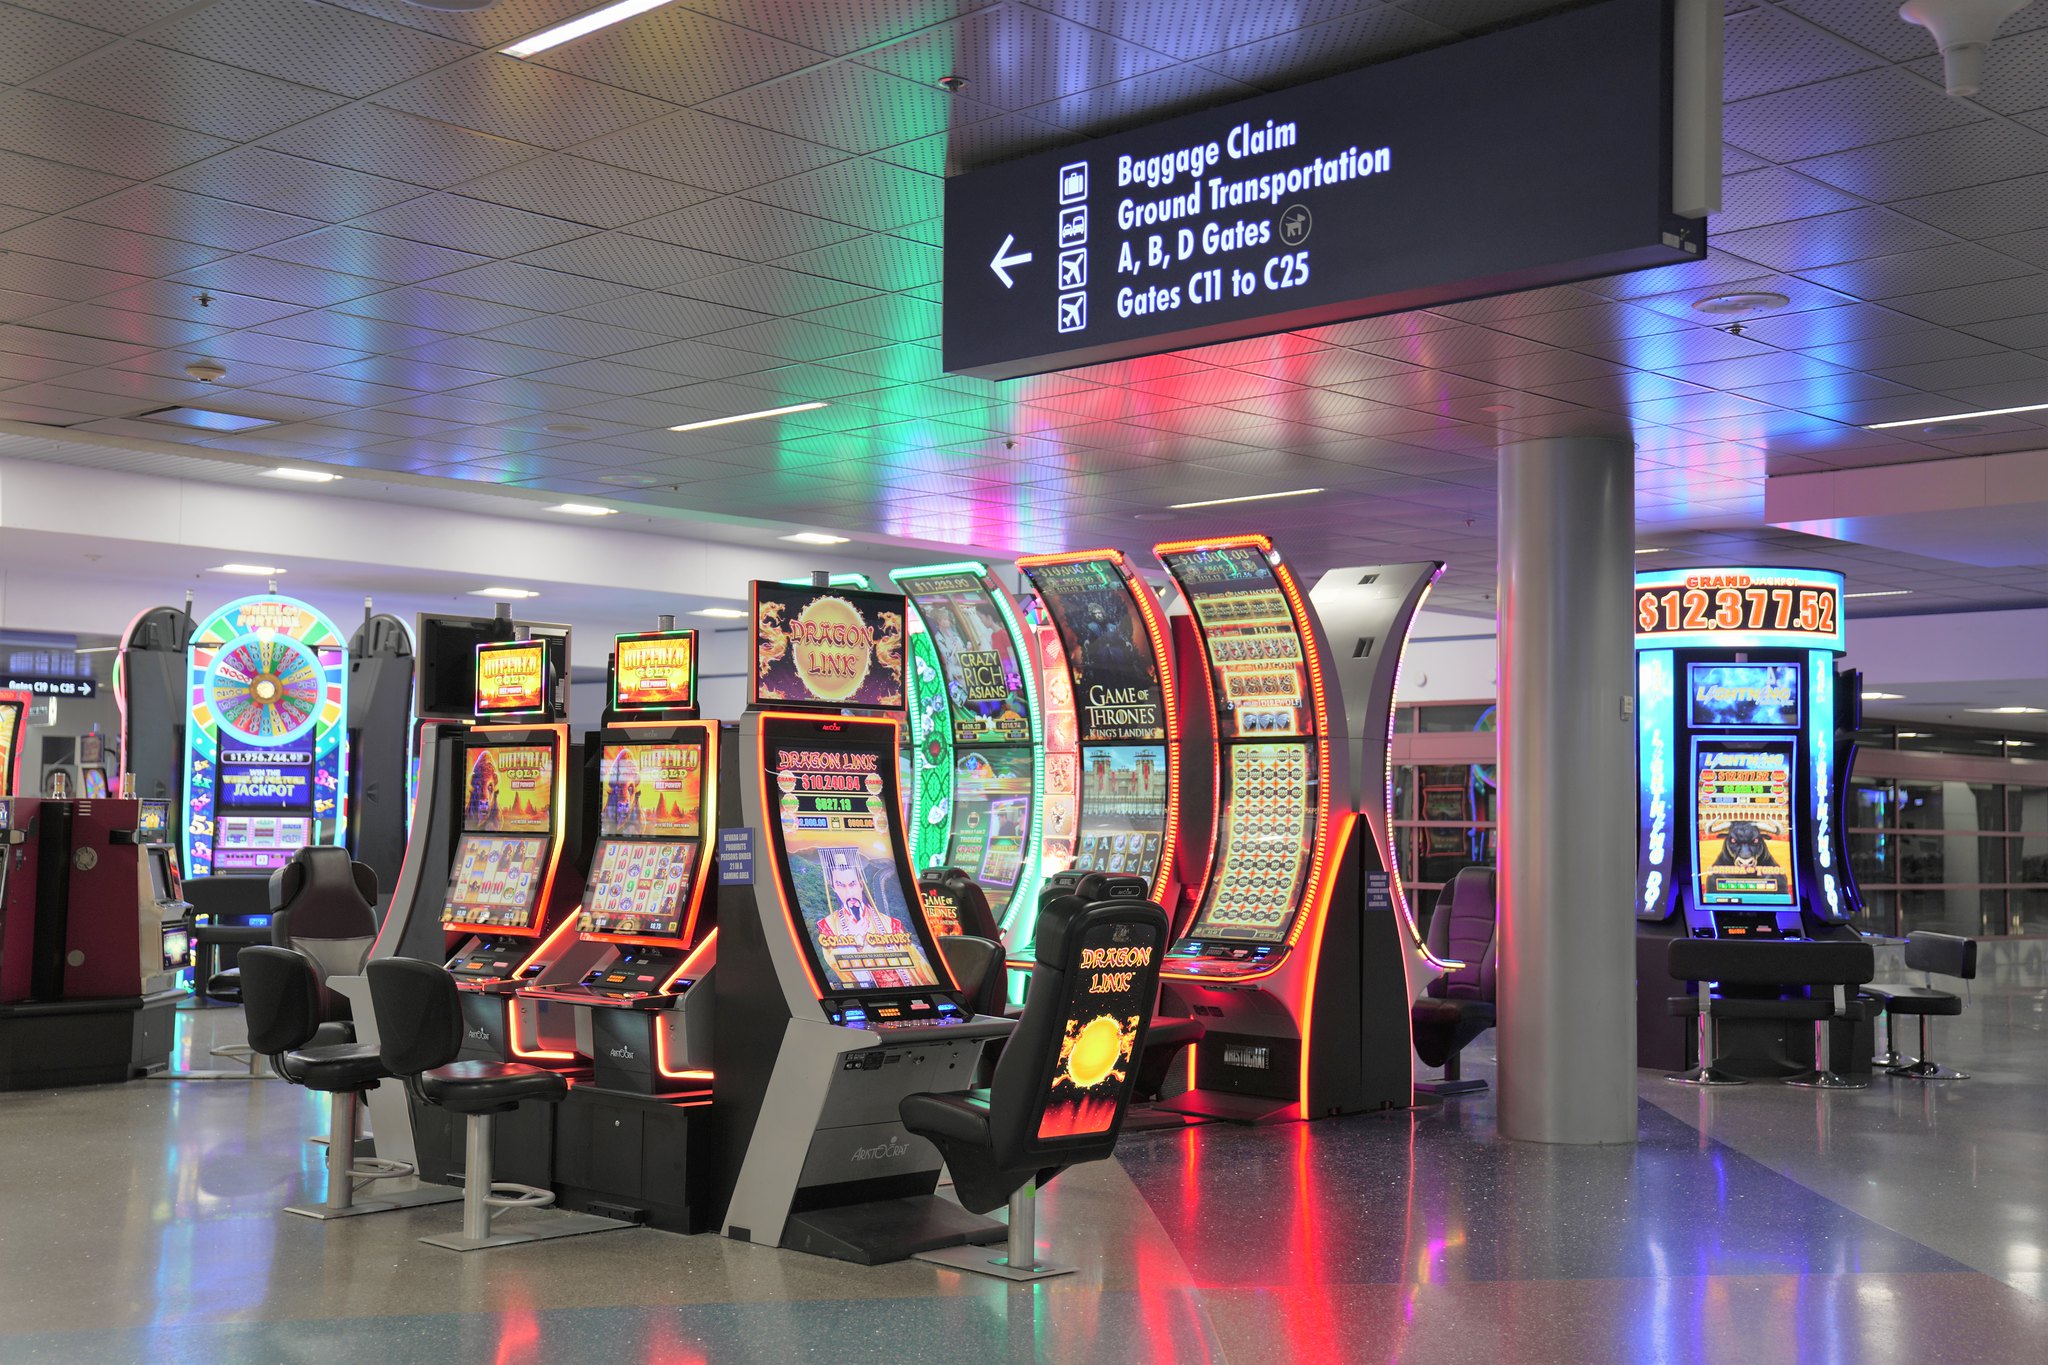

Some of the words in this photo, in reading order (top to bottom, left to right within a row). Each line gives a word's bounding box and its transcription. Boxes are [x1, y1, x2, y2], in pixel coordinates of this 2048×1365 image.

[1118, 141, 1219, 187] Baggage
[1227, 120, 1296, 159] Claim
[1118, 182, 1200, 230] Ground
[1208, 146, 1390, 209] Transportation
[1118, 243, 1140, 276] A,
[1148, 235, 1170, 270] B,
[1178, 229, 1194, 260] D
[1202, 219, 1270, 255] Gates
[1117, 282, 1180, 318] Gates
[1188, 270, 1221, 305] C11
[1232, 268, 1255, 297] to
[1264, 252, 1310, 290] C25
[1686, 575, 1751, 589] GRAND
[1639, 589, 1834, 631] $12,377.52
[789, 619, 874, 649] DRAGON
[808, 654, 857, 678] LINK
[960, 652, 997, 667] CRAZY
[963, 665, 1004, 686] RICH
[968, 685, 1006, 699] ASIANS
[1089, 685, 1136, 706] GAME
[1137, 690, 1149, 701] OF
[1227, 701, 1234, 710] 3
[1086, 707, 1155, 728] THRONES
[1089, 728, 1117, 738] KING'S
[778, 750, 840, 770] DRAGON
[843, 753, 877, 770] LINK
[249, 768, 265, 776] WIN
[233, 784, 295, 797] JACKPOT
[633, 847, 643, 859] 10
[480, 881, 491, 894] 10
[492, 881, 503, 894] 10
[818, 933, 864, 947] GOLDE
[866, 932, 912, 946] CENTURY
[1080, 947, 1152, 969] DRAGON
[1089, 972, 1132, 994] LINK
